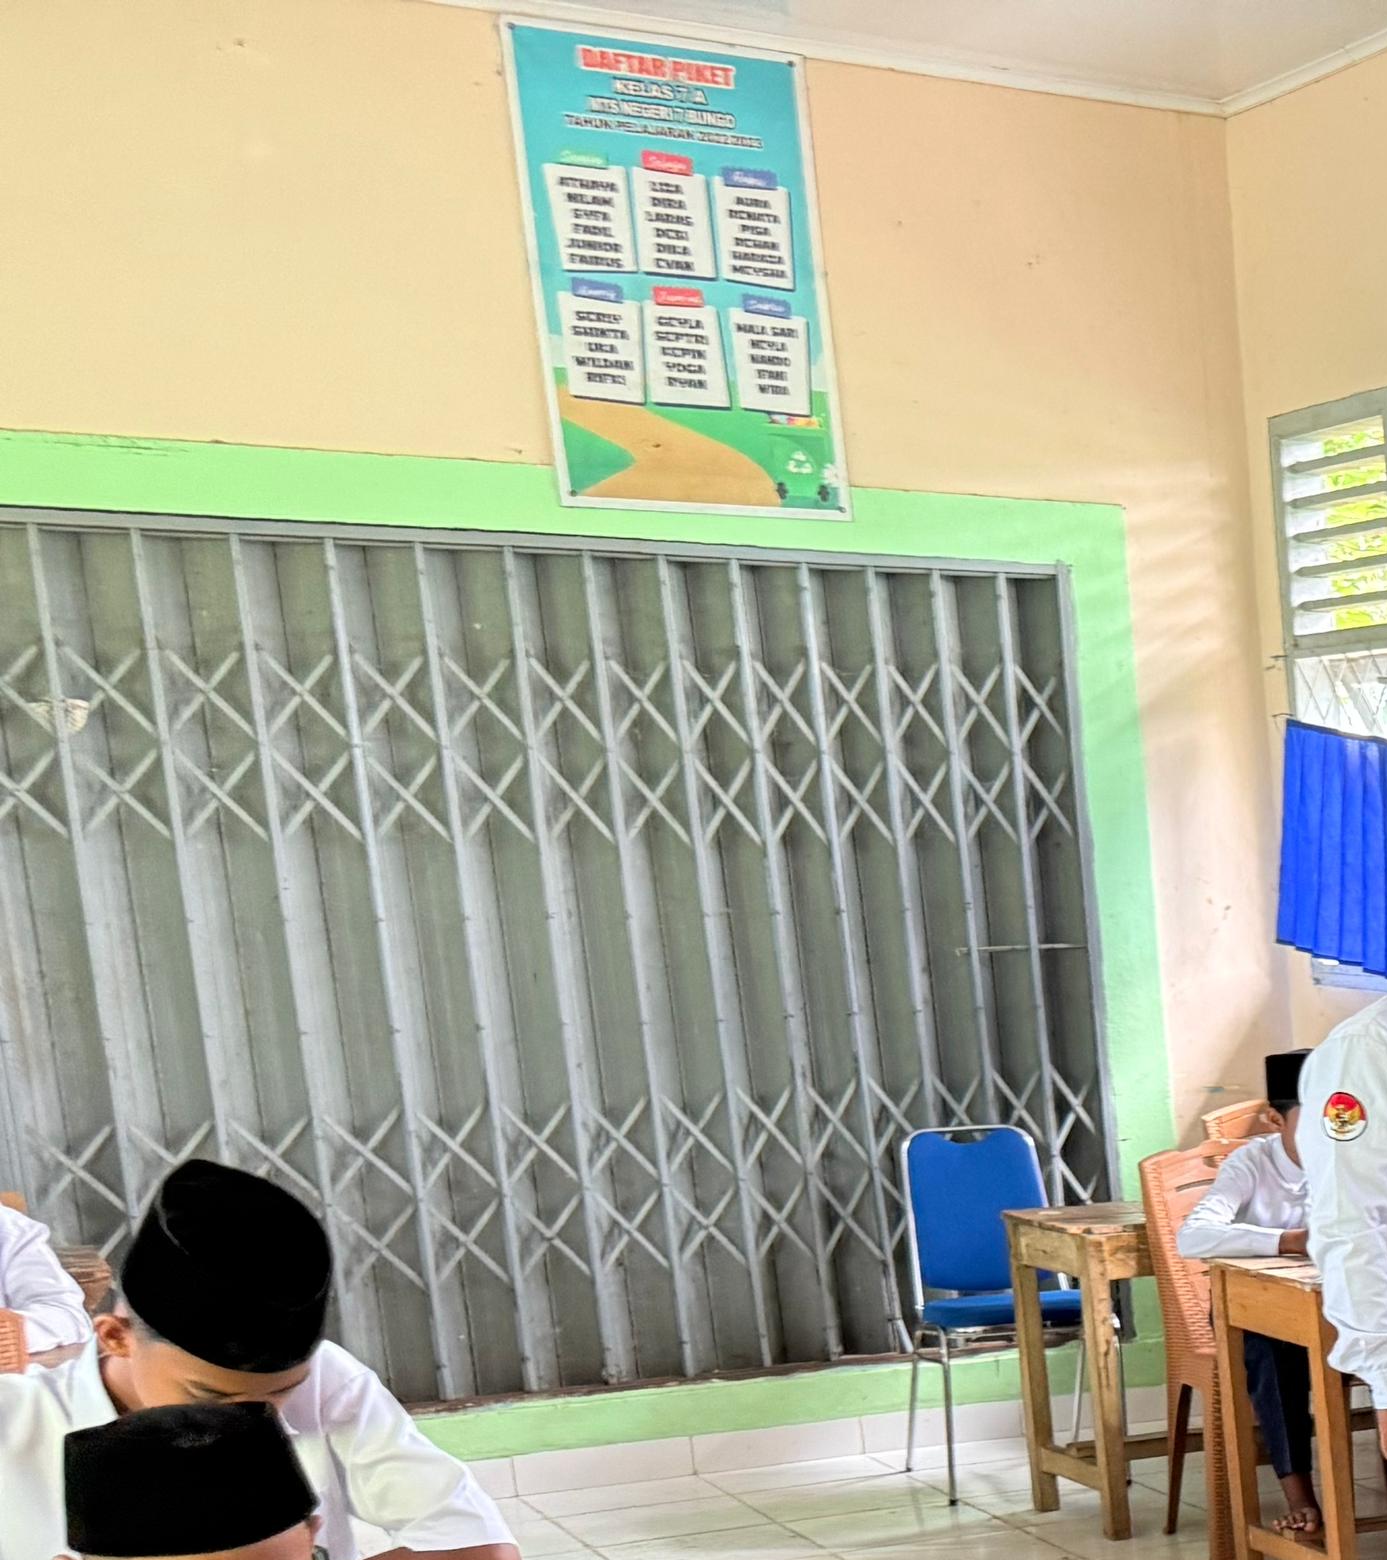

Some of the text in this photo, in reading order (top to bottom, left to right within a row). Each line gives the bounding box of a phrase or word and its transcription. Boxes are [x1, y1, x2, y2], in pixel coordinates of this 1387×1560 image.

[578, 46, 735, 88] DAFTAR PIKET
[613, 78, 674, 99] KELAS
[621, 100, 672, 121] NEGERI
[686, 108, 737, 130] BUNGO
